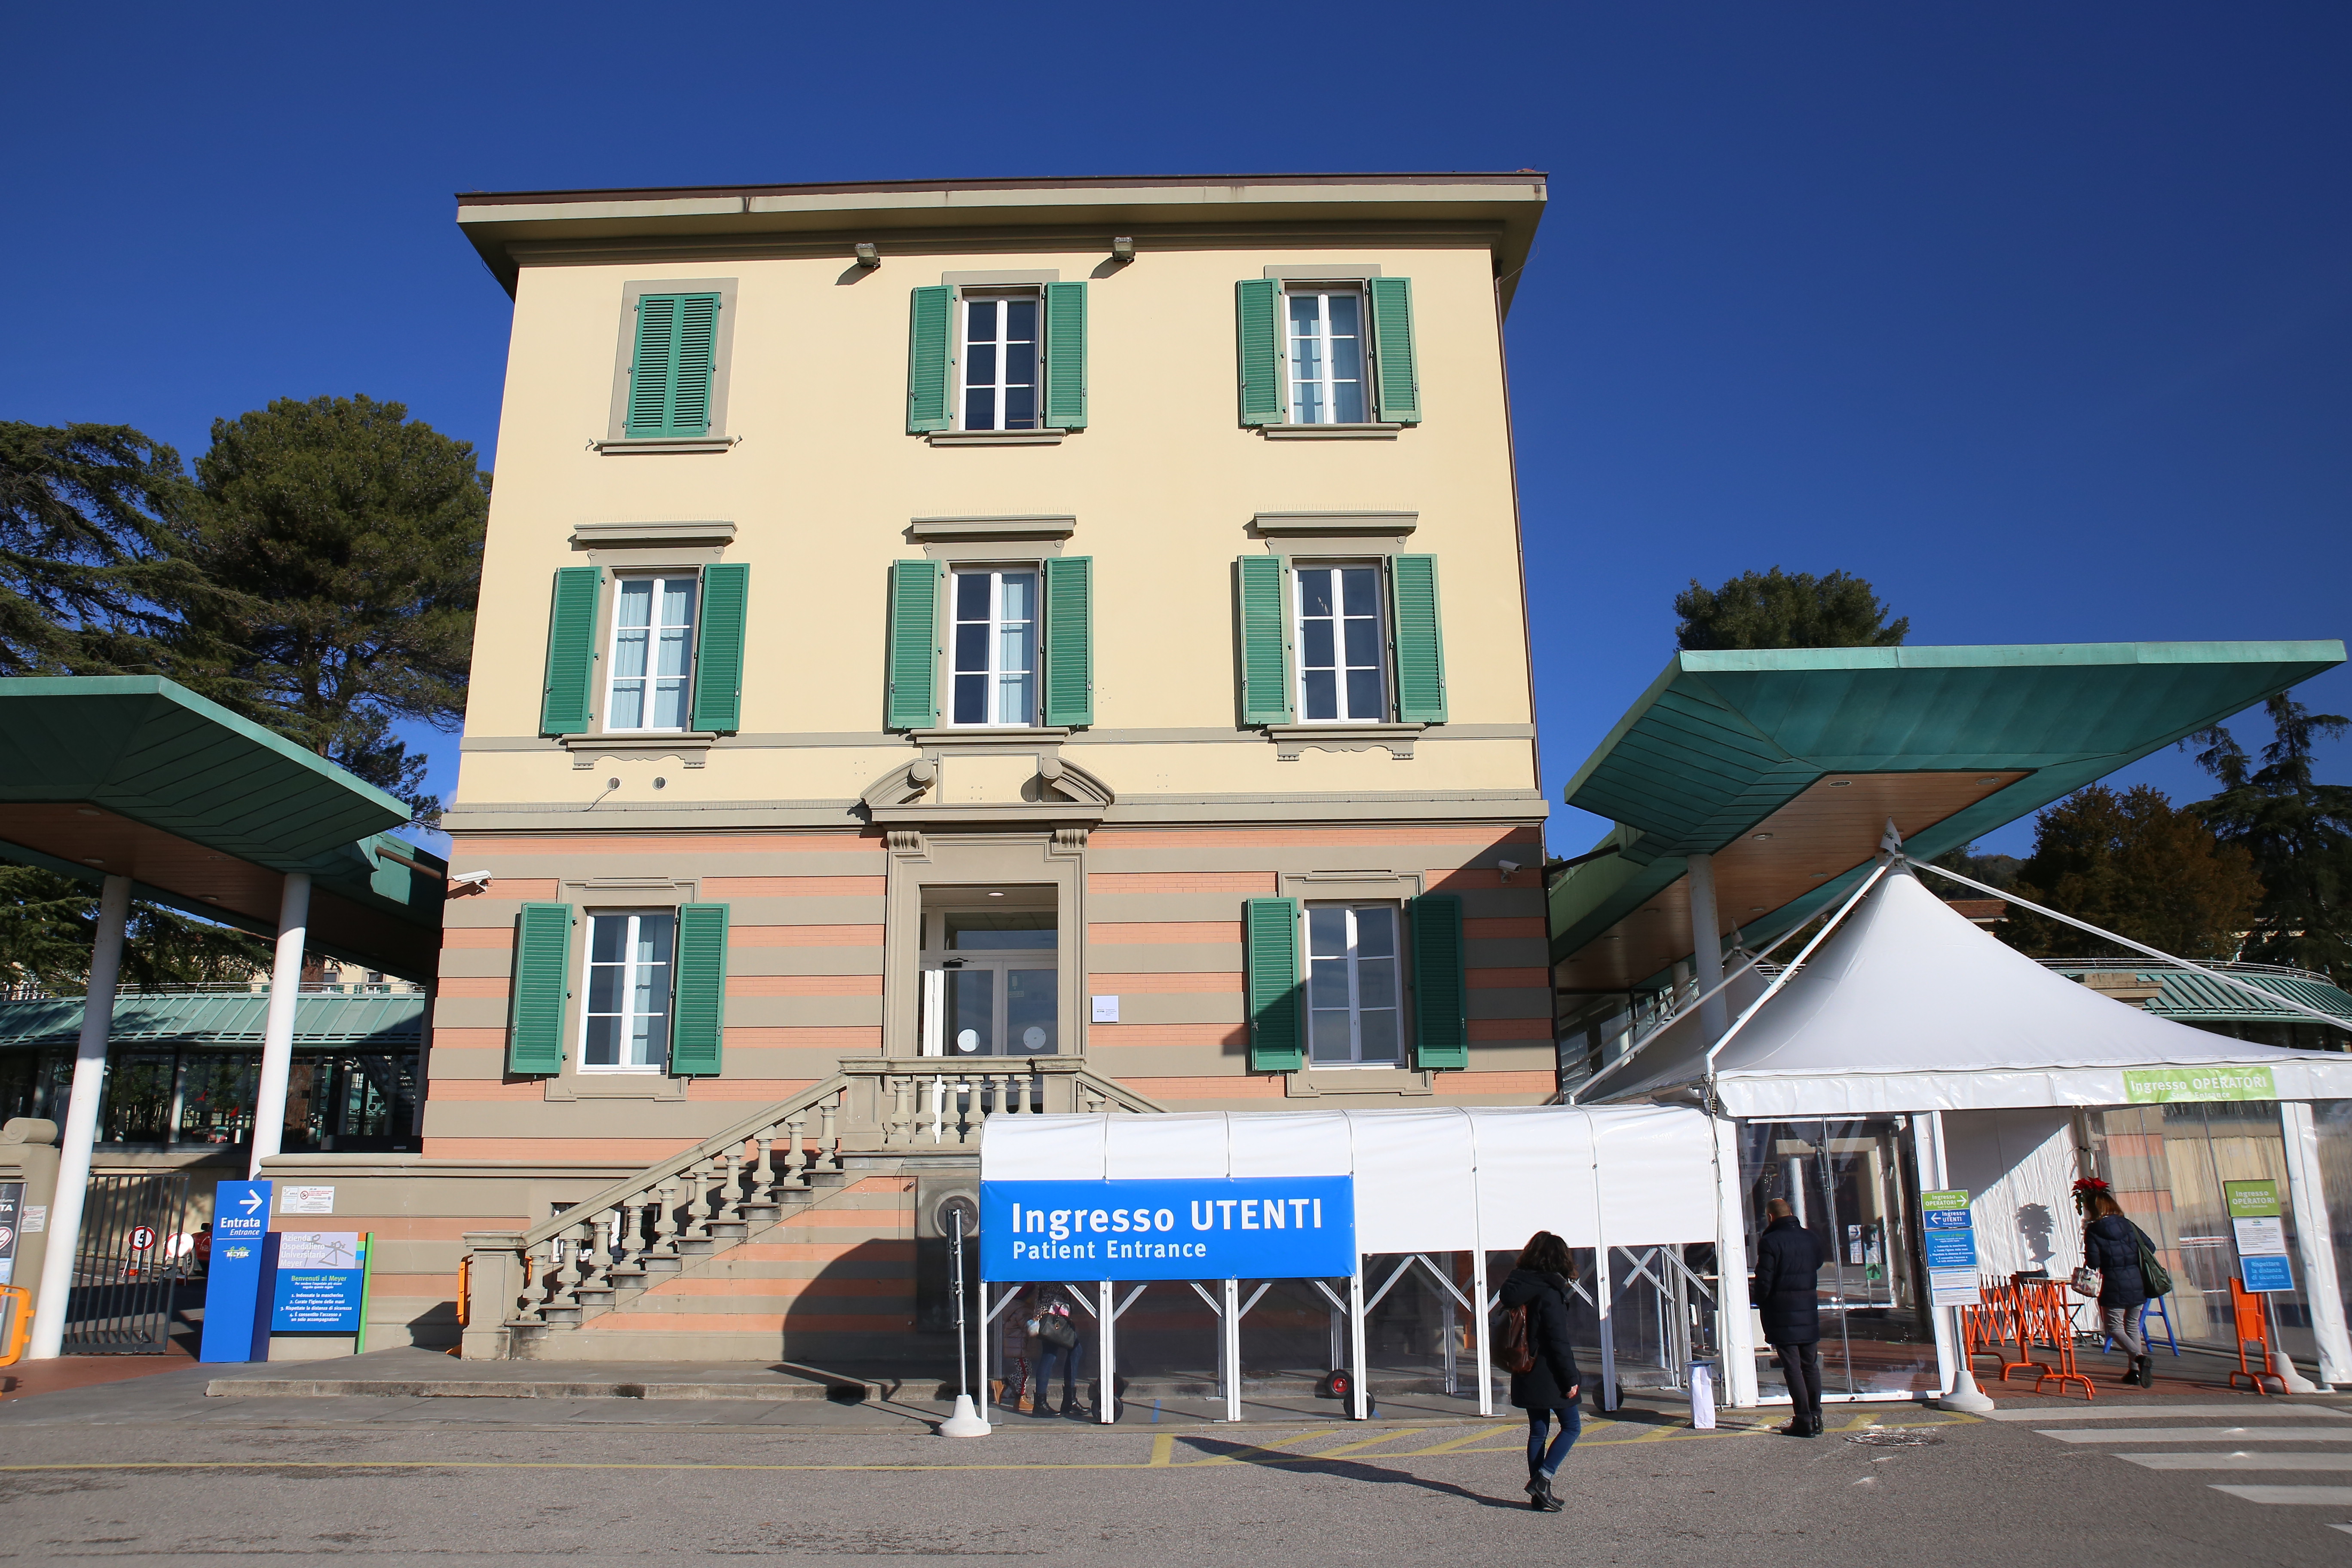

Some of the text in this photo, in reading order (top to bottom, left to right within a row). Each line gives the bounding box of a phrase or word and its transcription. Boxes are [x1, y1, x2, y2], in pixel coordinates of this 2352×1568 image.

[2130, 1076, 2267, 1093] Ingresso OPERATORI
[220, 1217, 260, 1228] Entrata
[1013, 1198, 1321, 1240] Ingresso UTENTI
[138, 1233, 145, 1244] 5
[282, 1242, 325, 1251] Ospedaliero
[1013, 1240, 1207, 1259] Patient Entrance
[280, 1259, 303, 1268] Meyer
